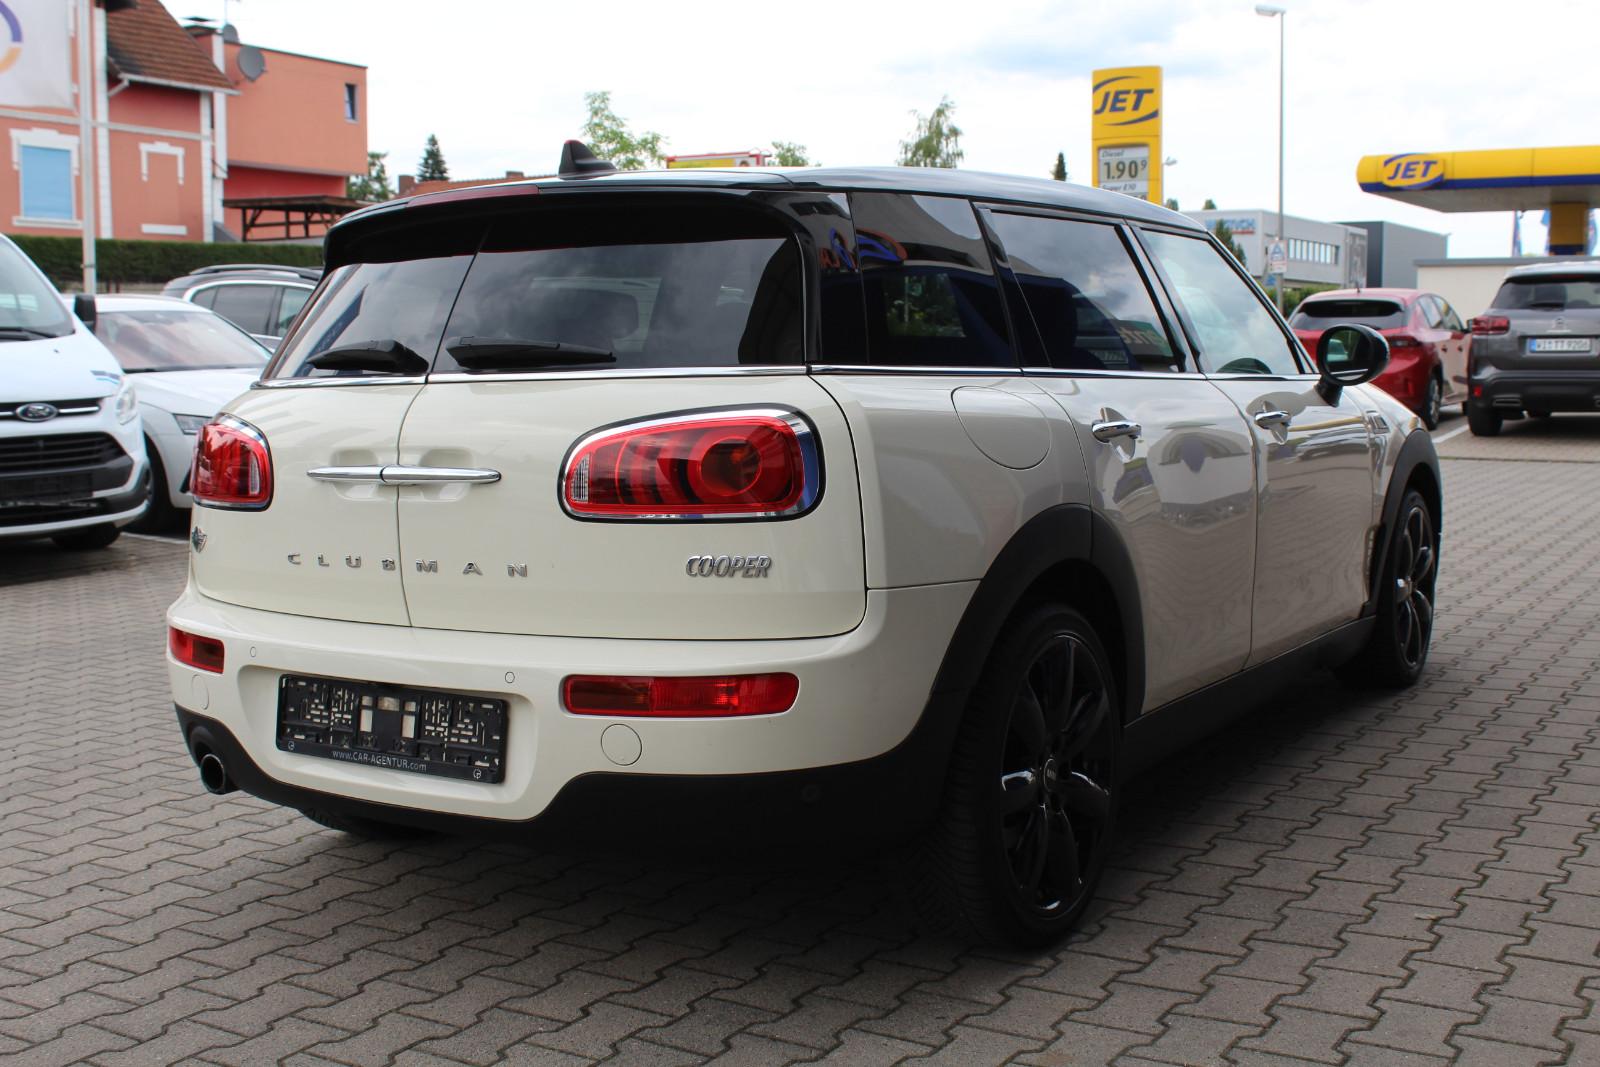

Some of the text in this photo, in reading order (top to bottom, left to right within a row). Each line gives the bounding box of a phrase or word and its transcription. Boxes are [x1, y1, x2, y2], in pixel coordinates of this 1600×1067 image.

[1094, 88, 1154, 115] JET
[1387, 160, 1438, 180] JET
[287, 553, 528, 578] CLUBMAN
[686, 555, 772, 578] COOPER
[332, 750, 427, 772] www.CAR-AGENTUR.com
